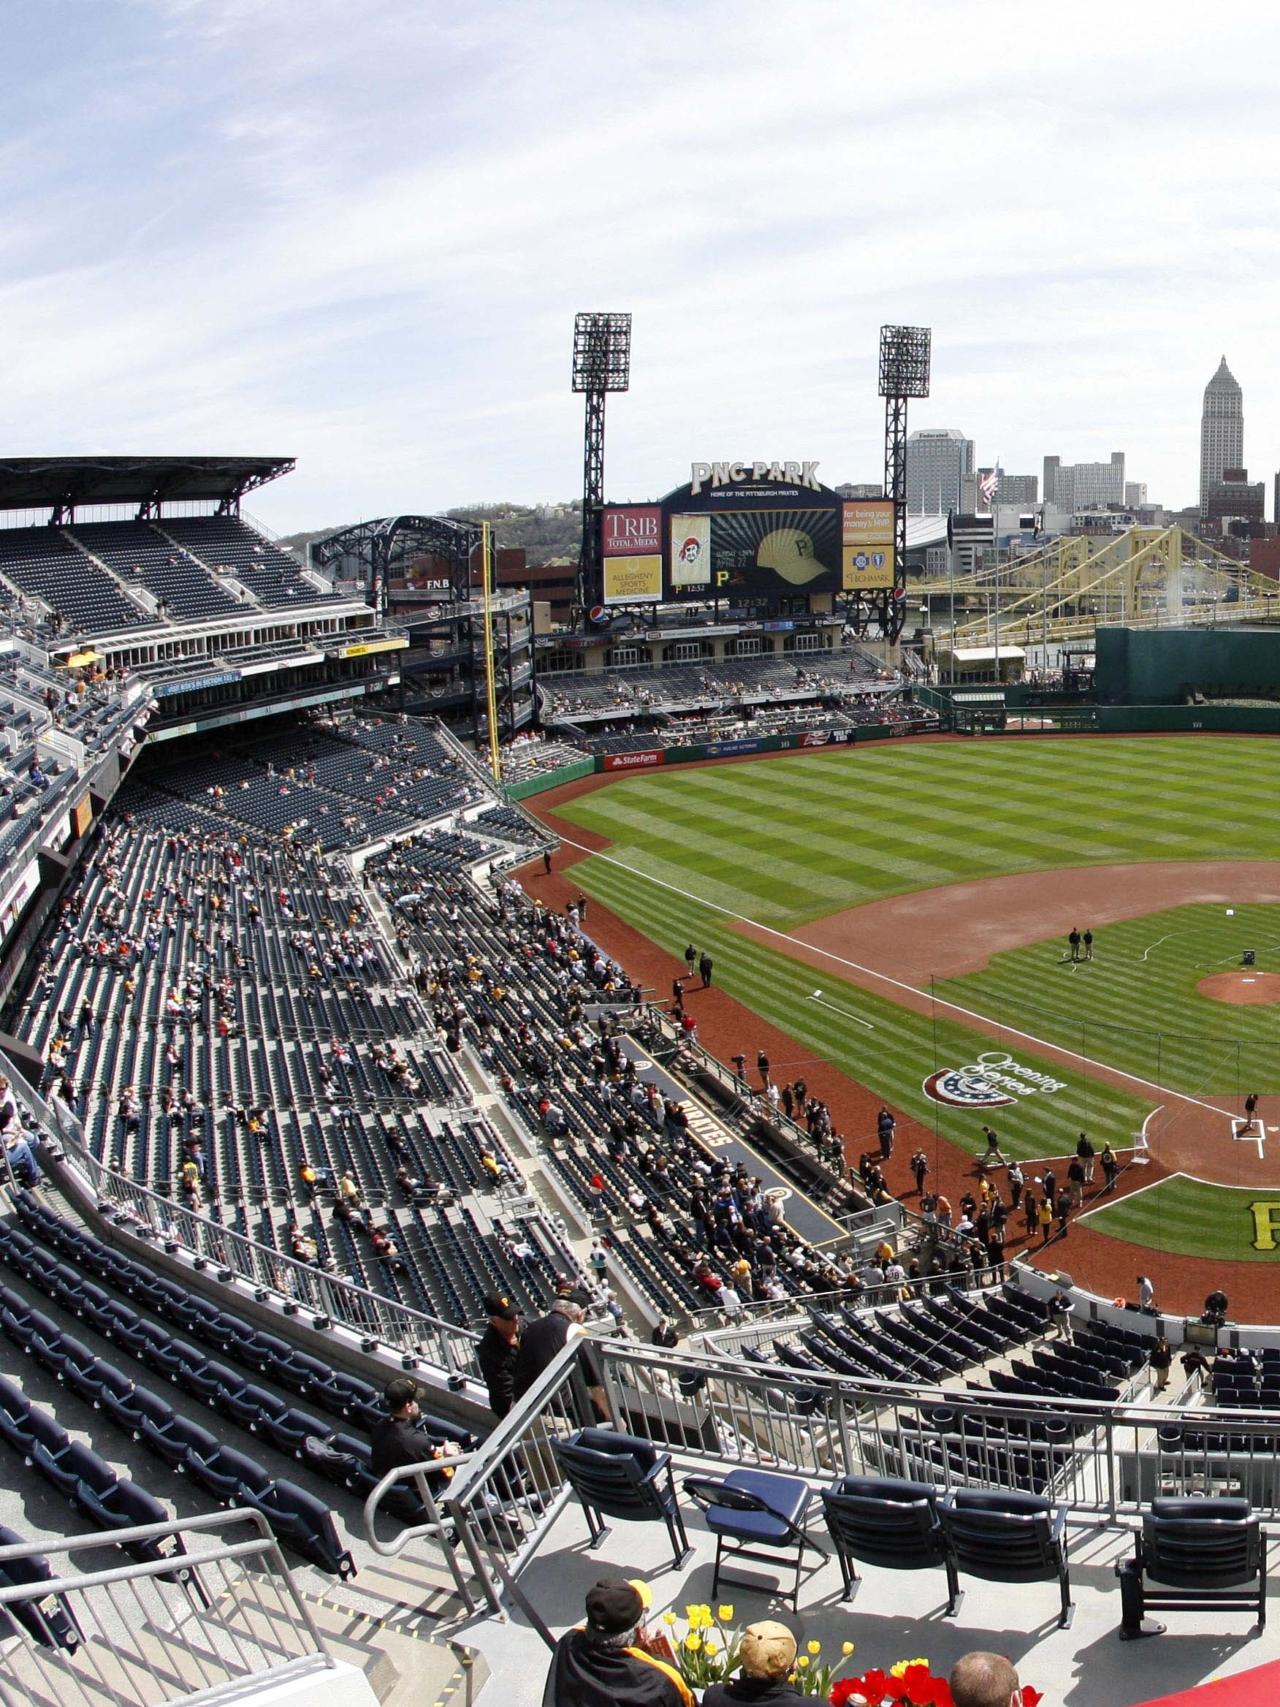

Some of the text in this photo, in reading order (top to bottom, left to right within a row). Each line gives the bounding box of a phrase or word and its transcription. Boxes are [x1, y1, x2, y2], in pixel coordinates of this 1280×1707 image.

[691, 461, 822, 496] PNC PARK
[607, 514, 658, 538] TRIB
[855, 510, 875, 520] being
[608, 538, 658, 548] TOTAL MEDIA
[613, 572, 654, 581] ALLEGHENY
[715, 570, 729, 587] P
[959, 1064, 1037, 1095] Series
[977, 1052, 1068, 1093] Opening
[678, 1099, 734, 1147] PIRATES
